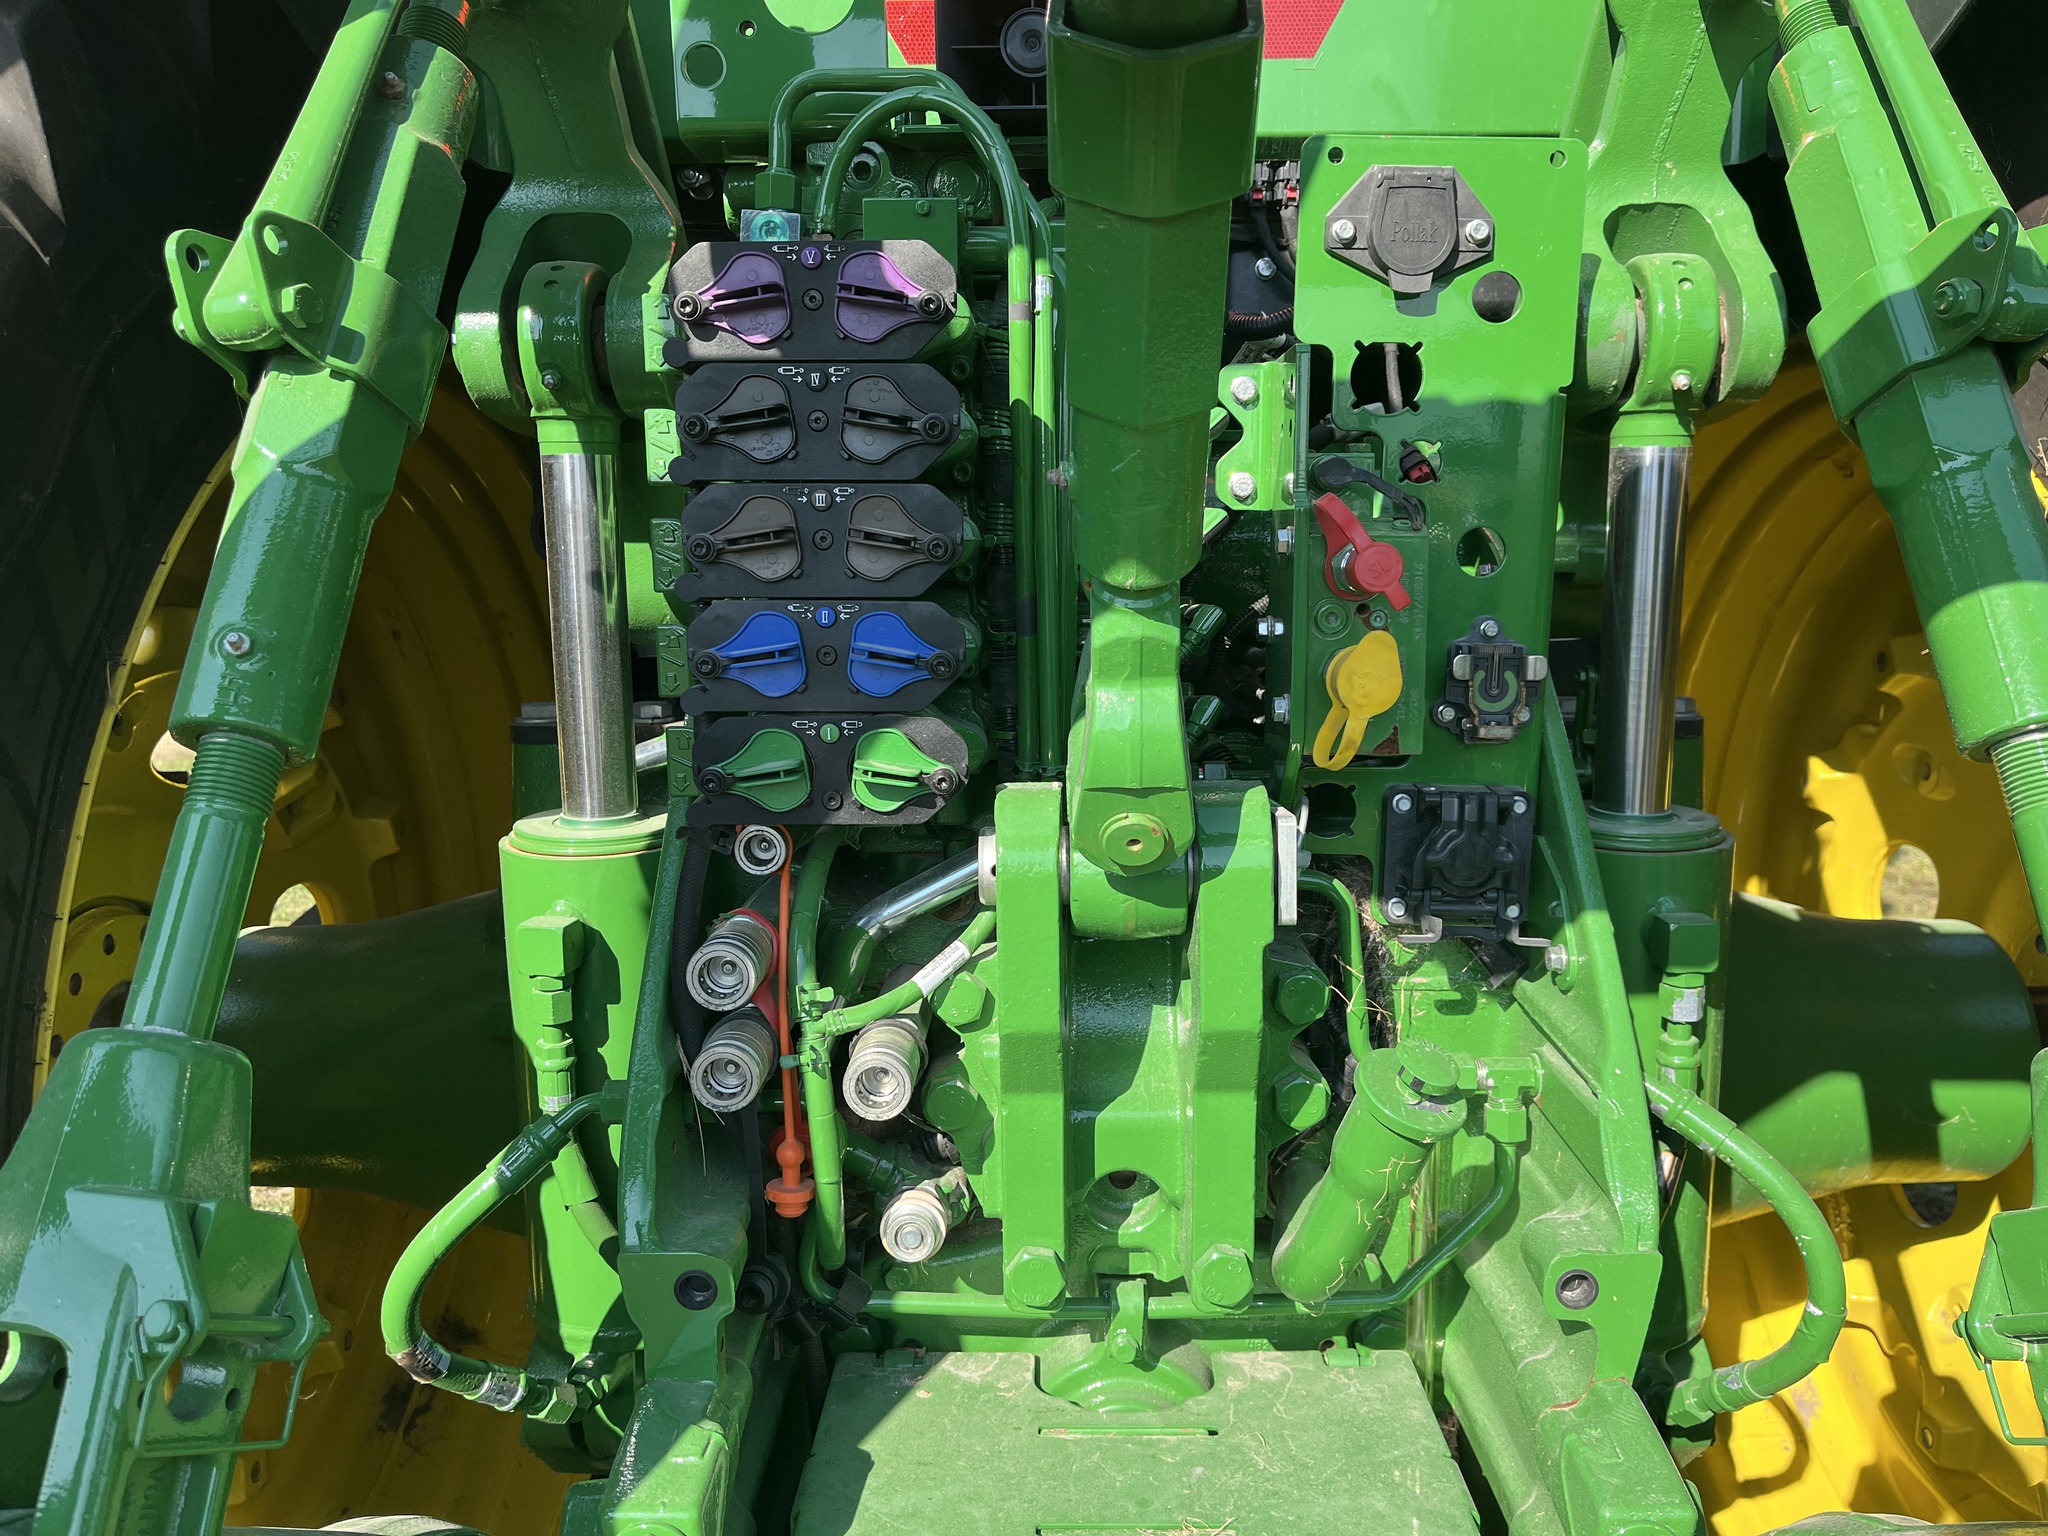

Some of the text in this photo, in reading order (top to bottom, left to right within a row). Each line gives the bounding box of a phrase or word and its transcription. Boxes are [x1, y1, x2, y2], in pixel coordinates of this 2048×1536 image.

[1391, 221, 1438, 243] Pollak
[805, 250, 816, 264] V
[810, 372, 821, 387] IV
[815, 493, 827, 507] III
[1368, 560, 1392, 579] SL
[821, 610, 829, 624] II
